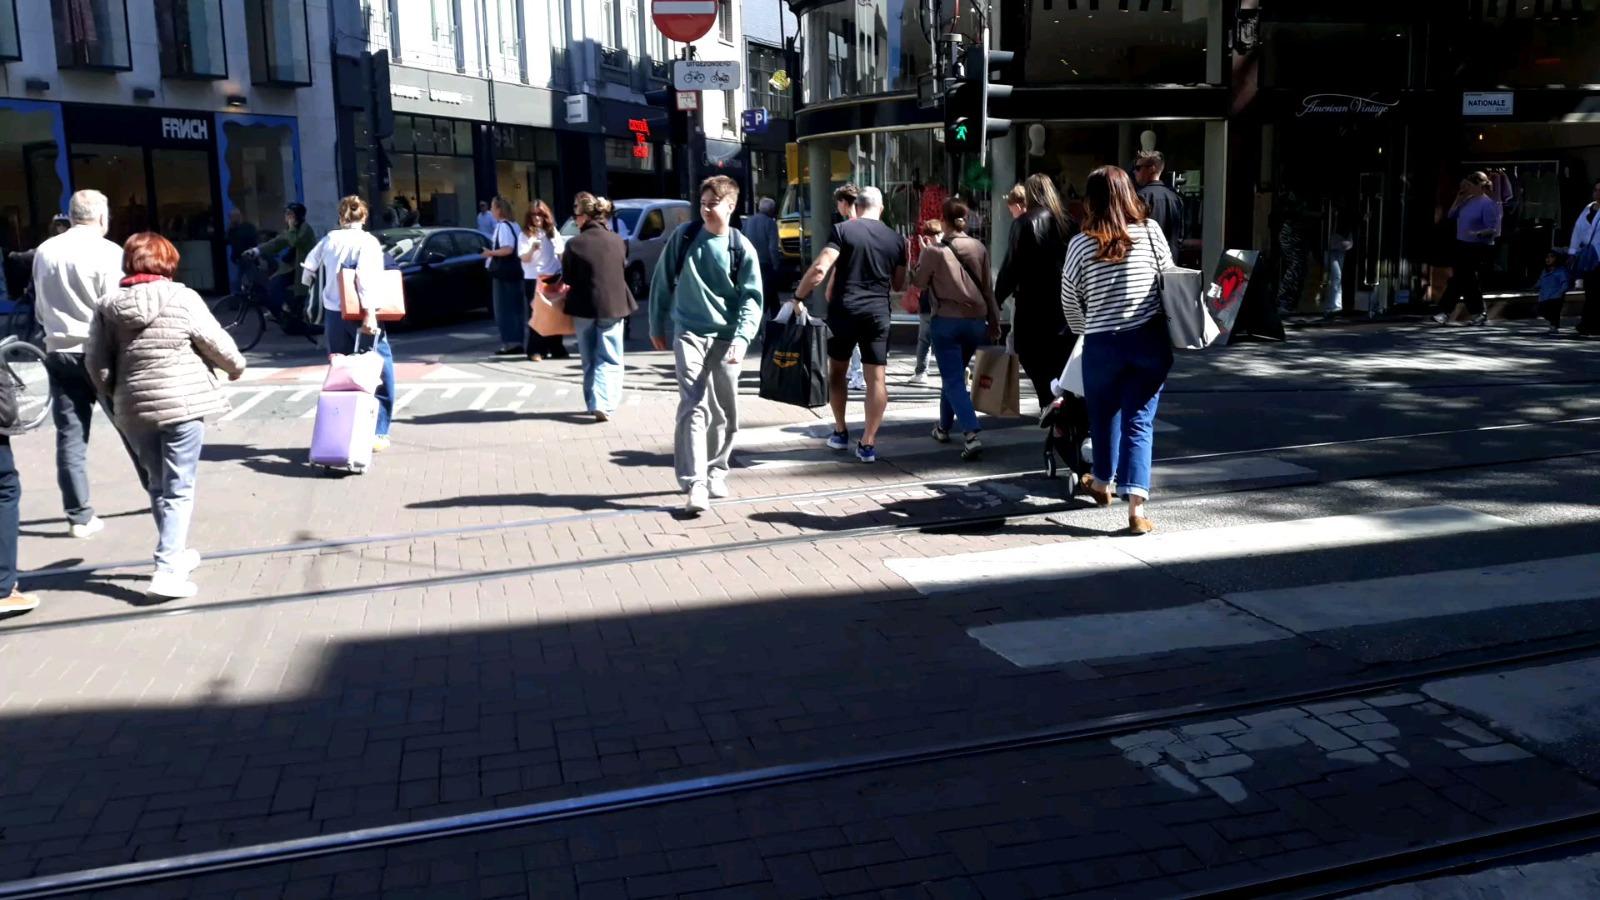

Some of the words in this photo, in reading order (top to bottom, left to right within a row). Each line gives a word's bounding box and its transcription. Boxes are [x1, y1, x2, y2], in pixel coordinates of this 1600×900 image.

[1296, 94, 1348, 117] American
[1468, 99, 1506, 107] NATIONALE
[755, 112, 764, 126] P
